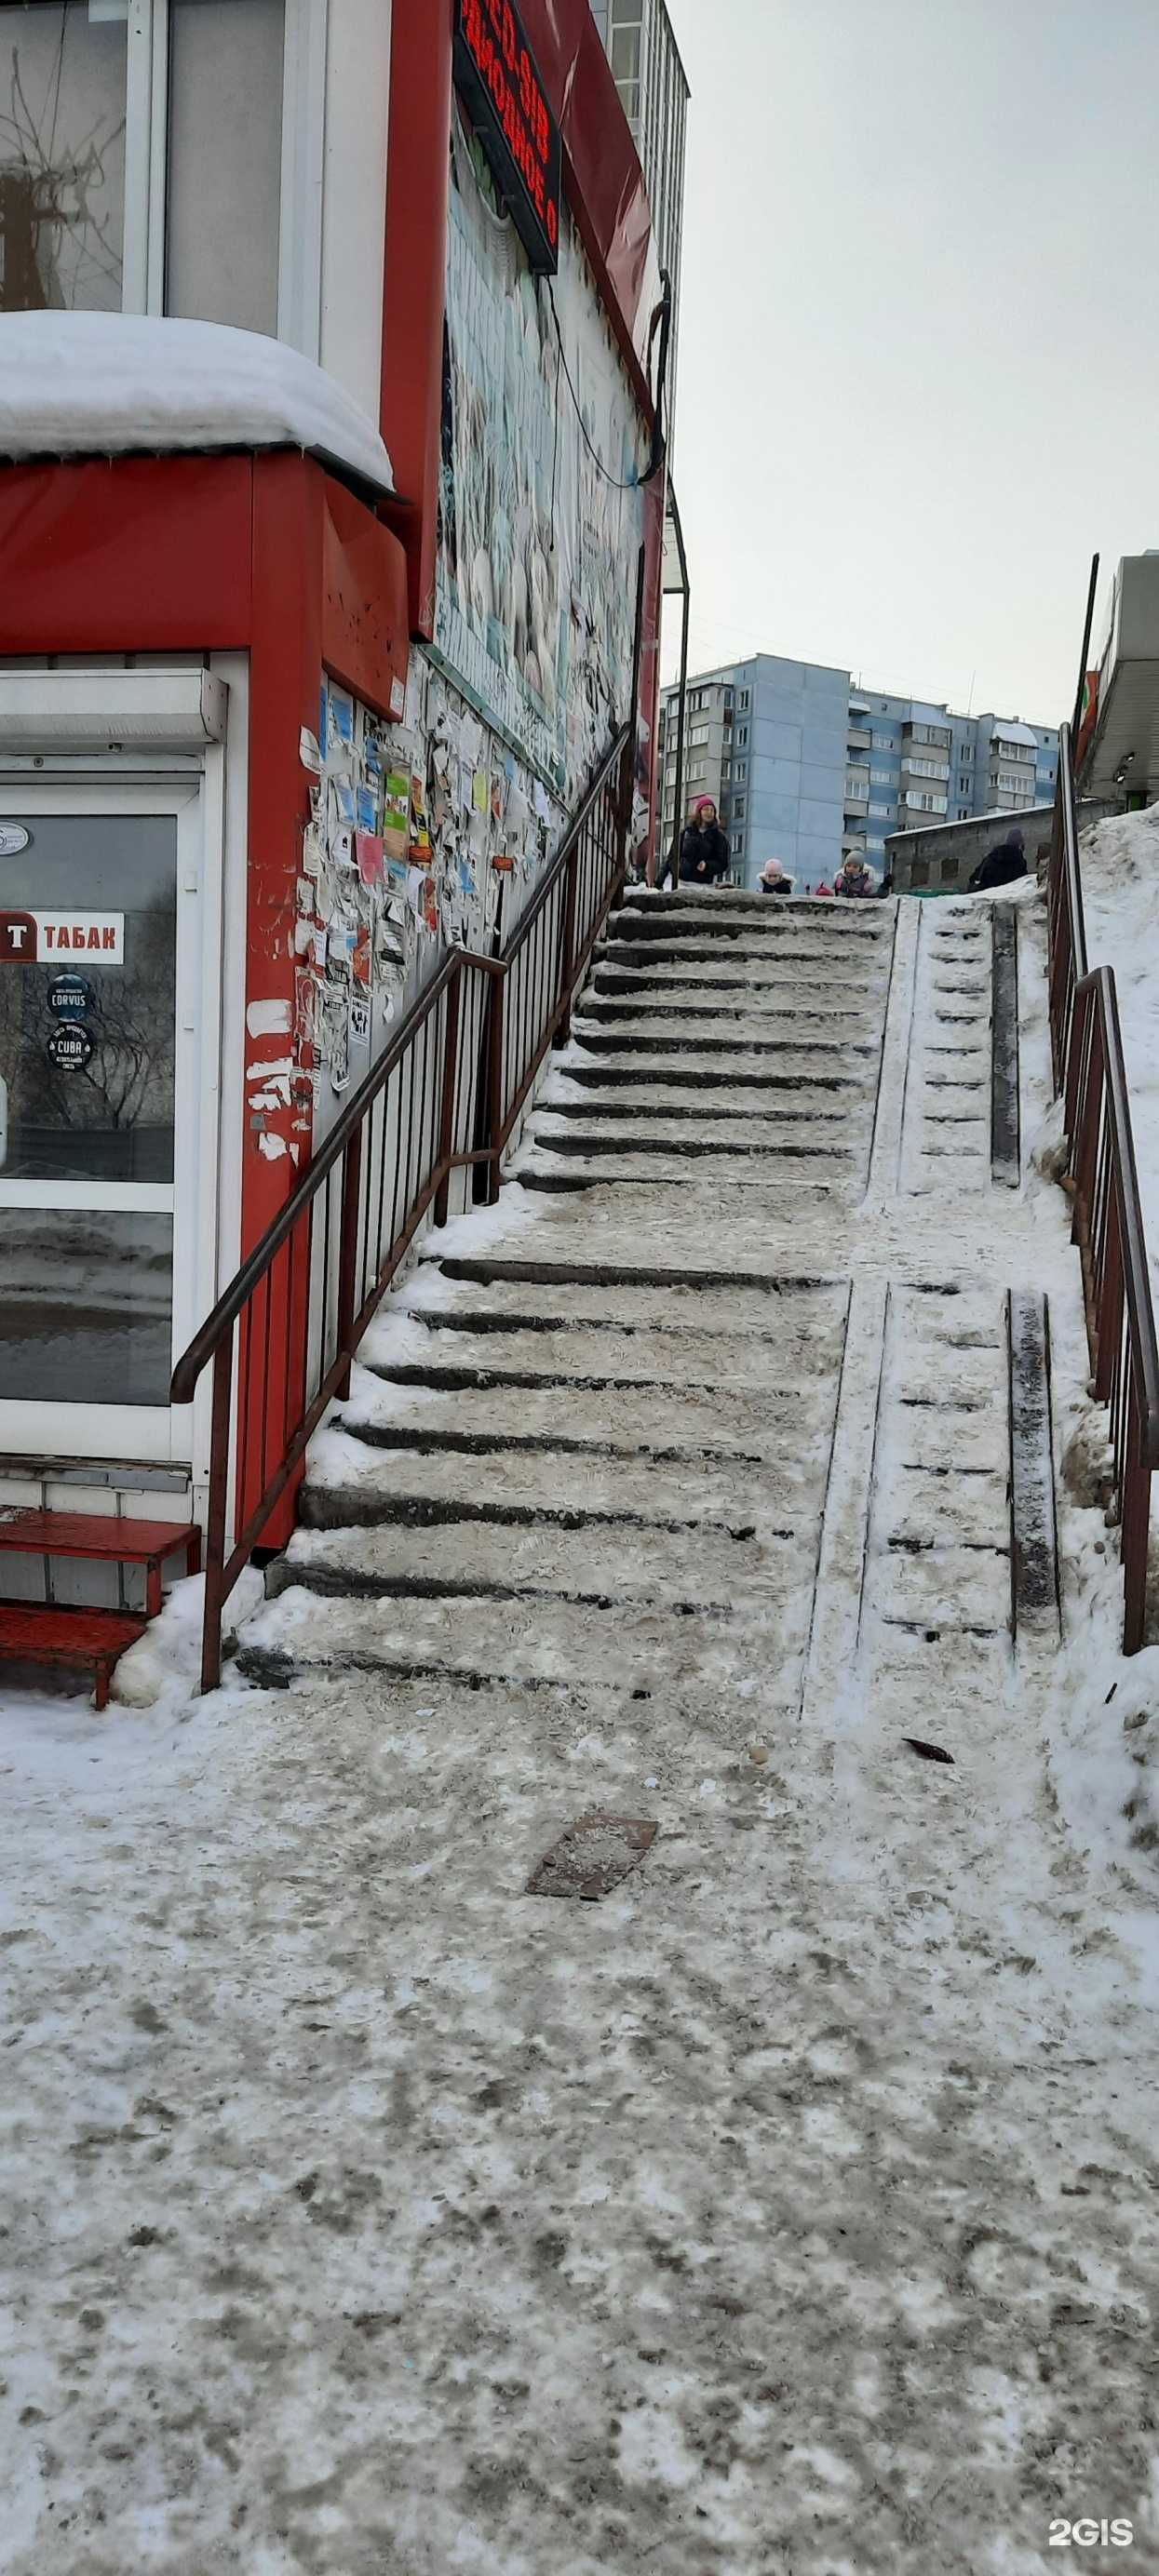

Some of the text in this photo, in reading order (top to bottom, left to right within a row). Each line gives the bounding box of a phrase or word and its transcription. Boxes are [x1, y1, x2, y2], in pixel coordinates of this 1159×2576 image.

[44, 926, 116, 949] ТАБАК
[51, 994, 86, 1007] CORVUS
[58, 1040, 82, 1054] CUBA
